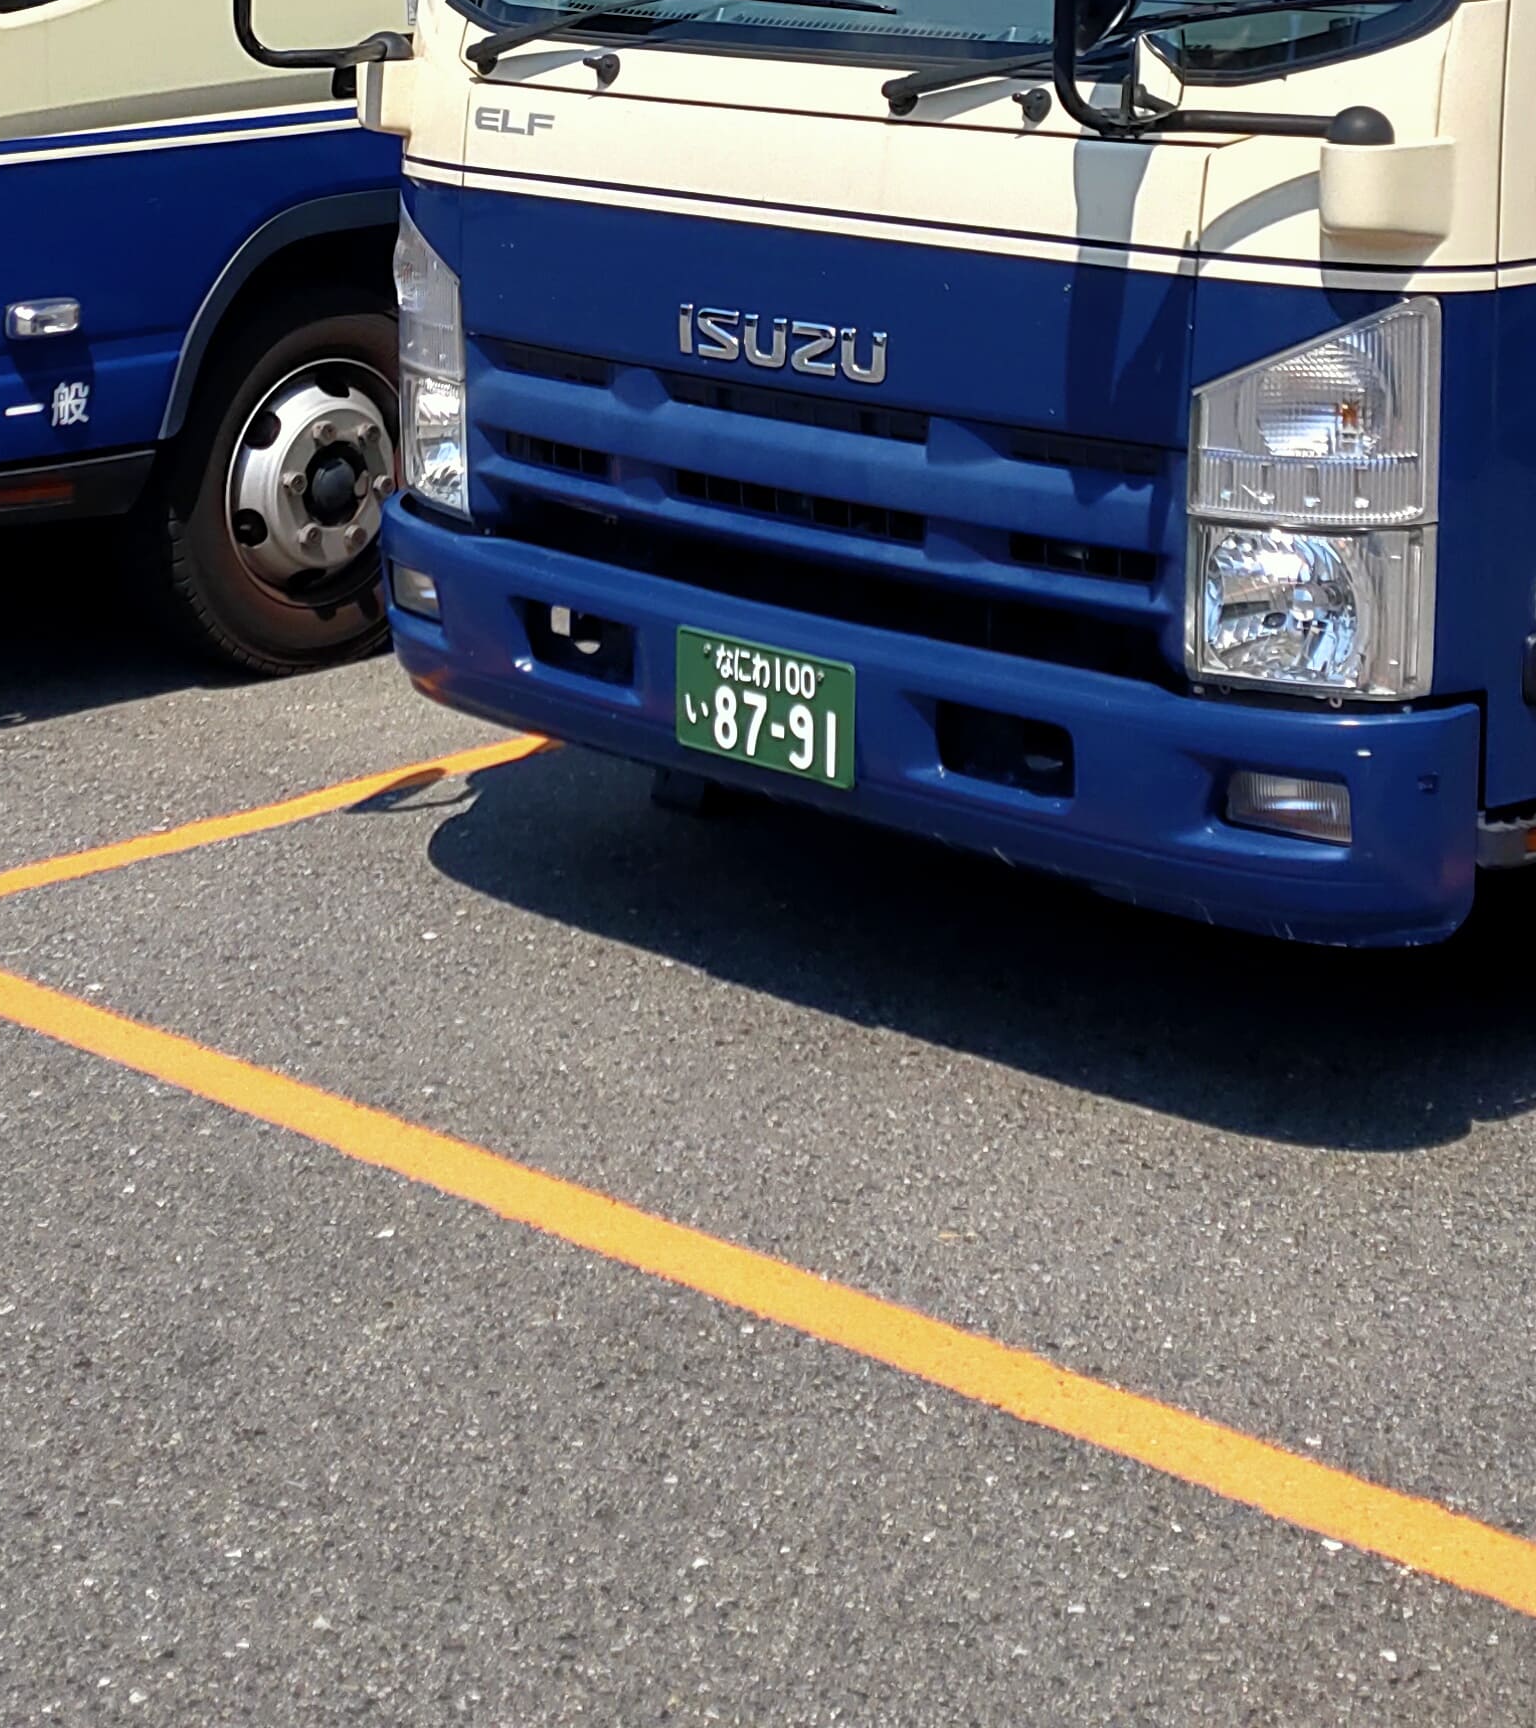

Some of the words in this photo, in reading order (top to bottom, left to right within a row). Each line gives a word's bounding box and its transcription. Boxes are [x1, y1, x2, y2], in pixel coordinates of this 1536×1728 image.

[475, 106, 555, 136] ELF
[679, 303, 888, 384] ISUZU
[5, 381, 90, 427] 一般
[685, 692, 709, 724] い
[714, 685, 837, 779] 87-91
